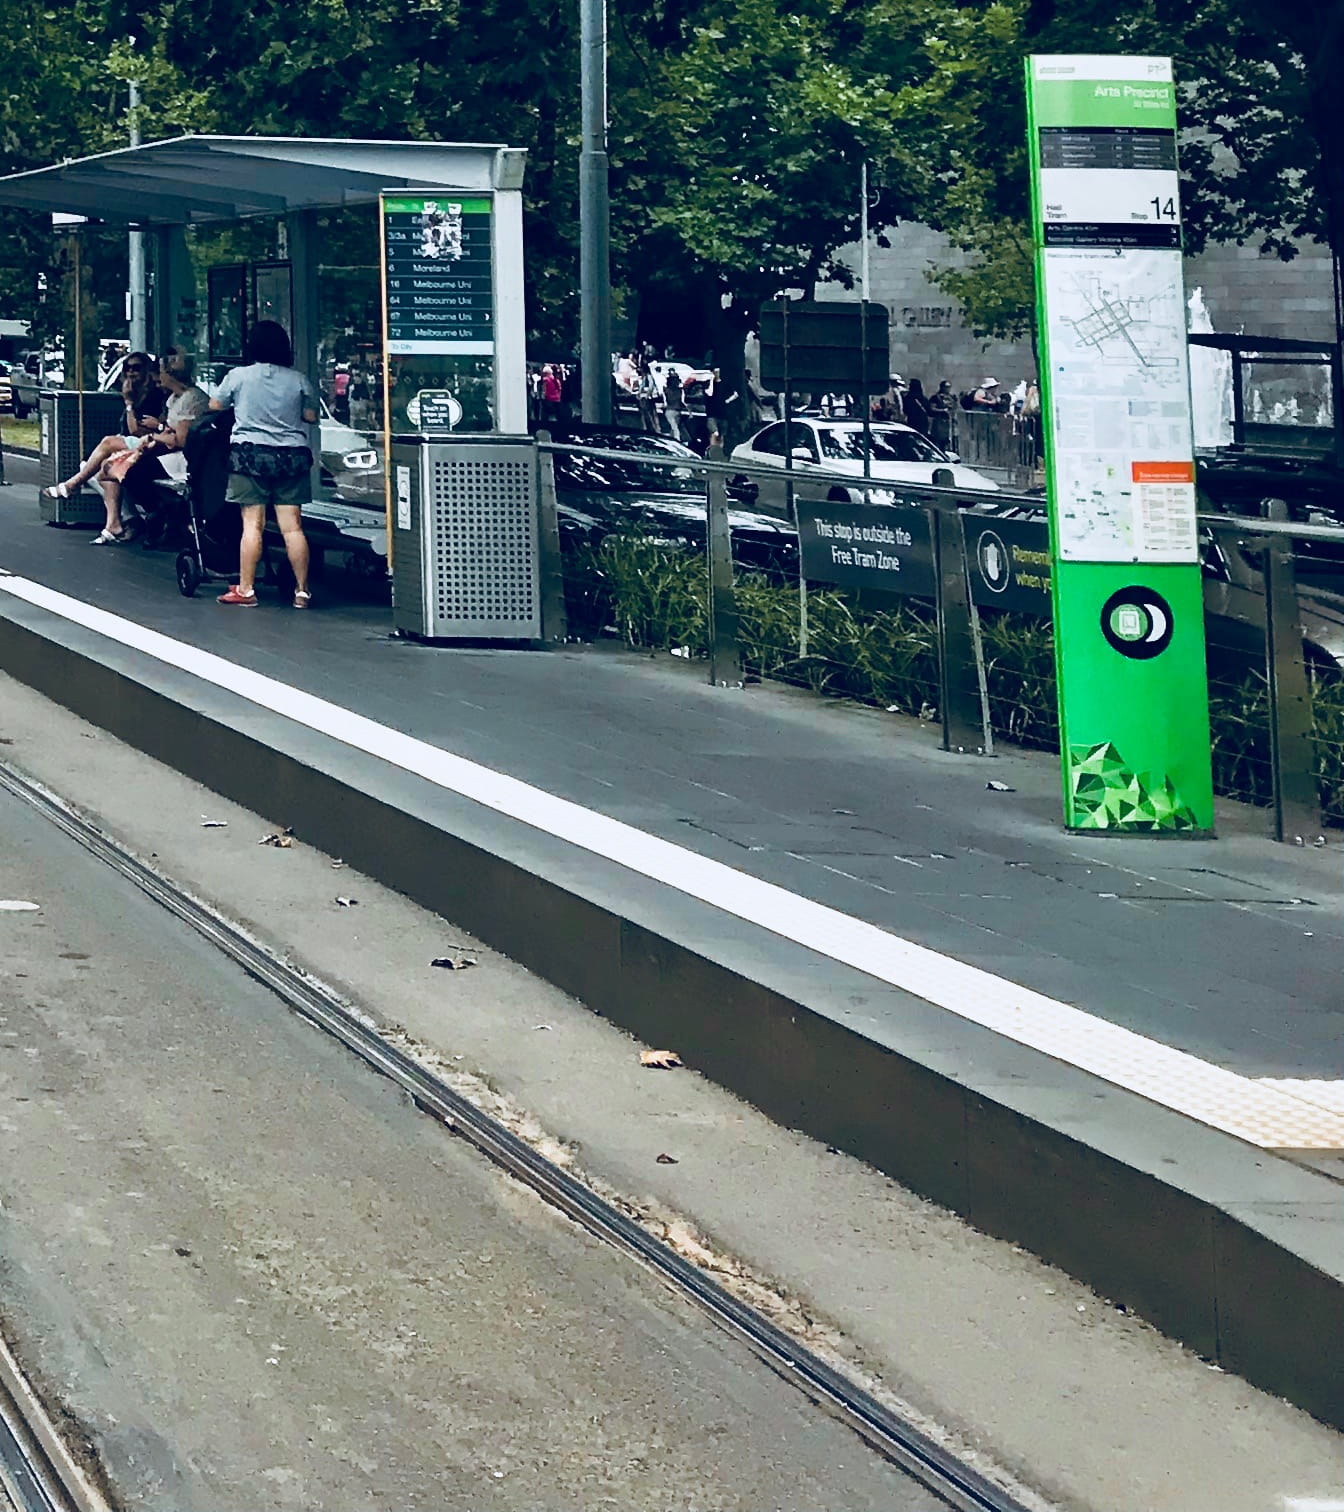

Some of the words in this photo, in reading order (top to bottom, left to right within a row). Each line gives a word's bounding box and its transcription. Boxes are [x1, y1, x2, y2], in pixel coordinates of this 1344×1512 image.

[1094, 85, 1121, 97] Arts
[1123, 85, 1169, 99] Precinct
[1150, 196, 1177, 221] 14
[413, 264, 450, 272] Moreland
[413, 280, 456, 289] Melbourne
[458, 280, 472, 289] Uni
[414, 296, 456, 305] Melbourne
[458, 296, 472, 305] Uni
[414, 312, 457, 320] Melbourne
[458, 312, 472, 320] Uni
[415, 328, 457, 337] Melbourne
[459, 328, 472, 337] Uni
[814, 517, 833, 538] This
[833, 521, 852, 544] stop
[852, 521, 862, 541] is
[862, 525, 895, 544] outside
[895, 526, 912, 546] the
[831, 544, 852, 565] Free
[851, 547, 877, 568] Tram
[876, 550, 900, 571] Zone
